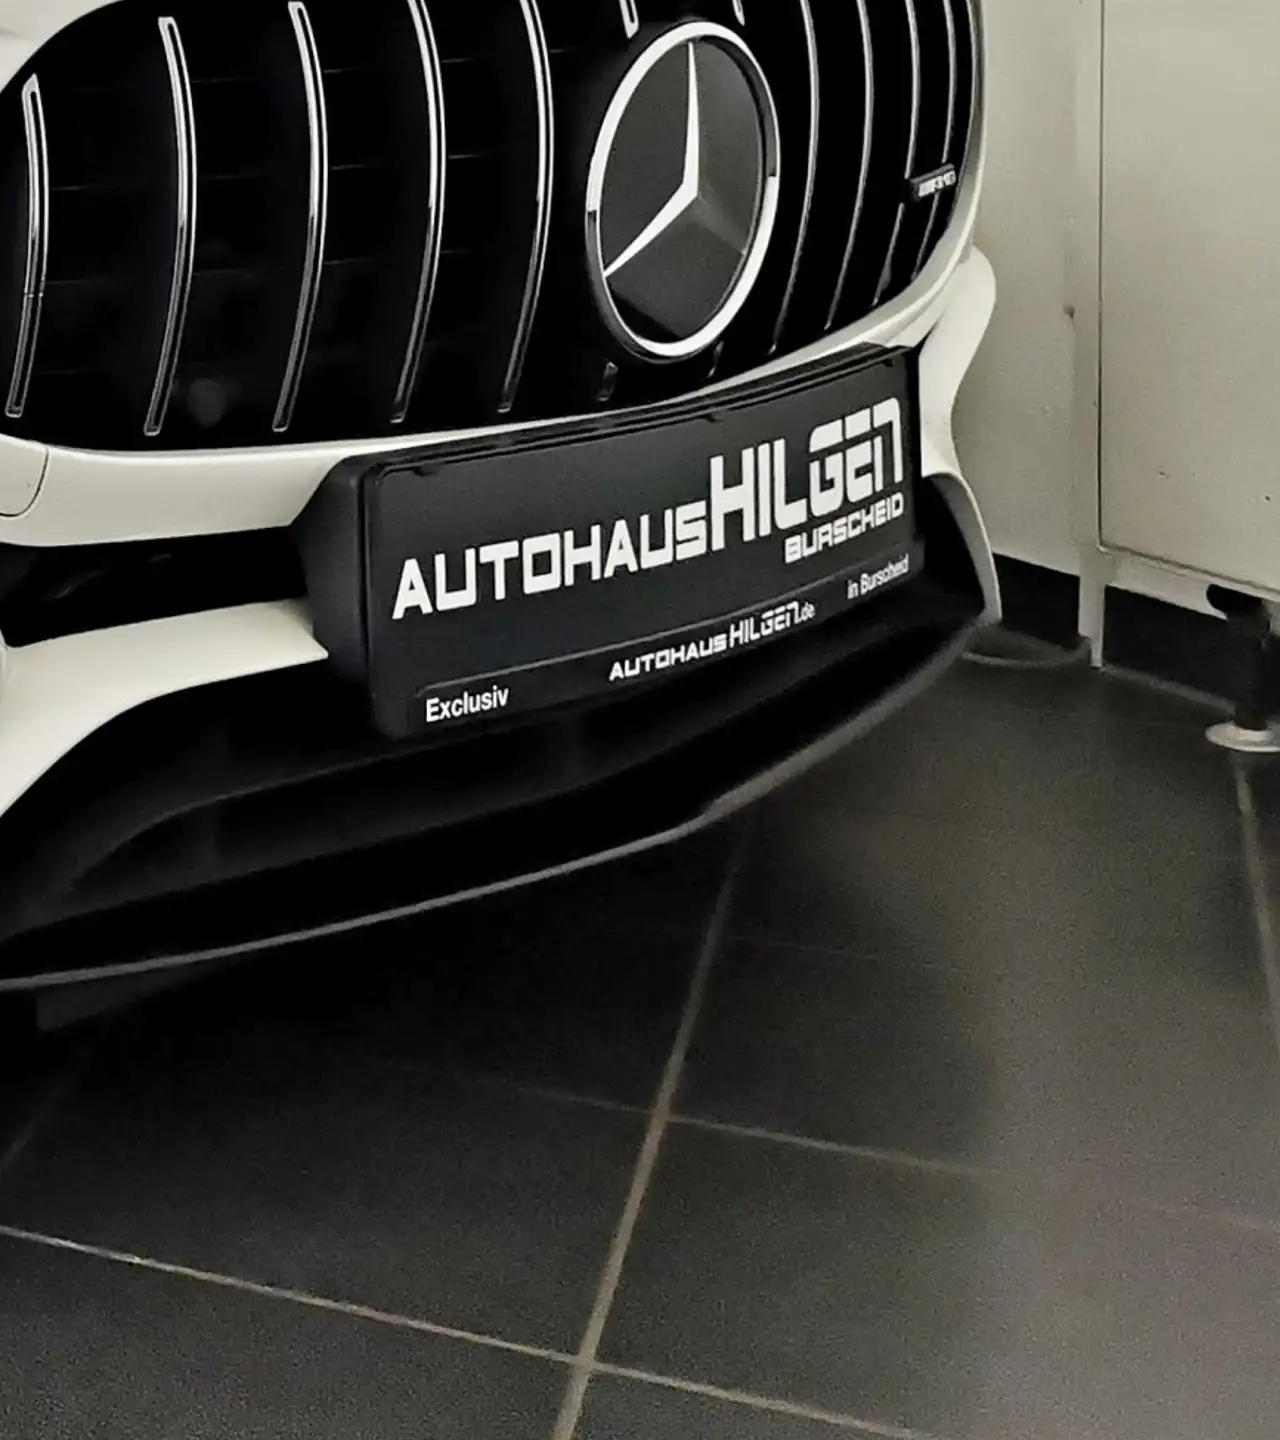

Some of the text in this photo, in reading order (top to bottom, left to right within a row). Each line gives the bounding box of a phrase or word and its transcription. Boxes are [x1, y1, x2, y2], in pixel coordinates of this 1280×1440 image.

[392, 397, 904, 620] AUTOHAUS HILGEN
[784, 491, 904, 563] BURSCHEID
[426, 684, 509, 723] Exclusiv
[608, 636, 728, 682] AUTOHAUS
[847, 578, 859, 600] in
[860, 553, 910, 595] Burscheid
